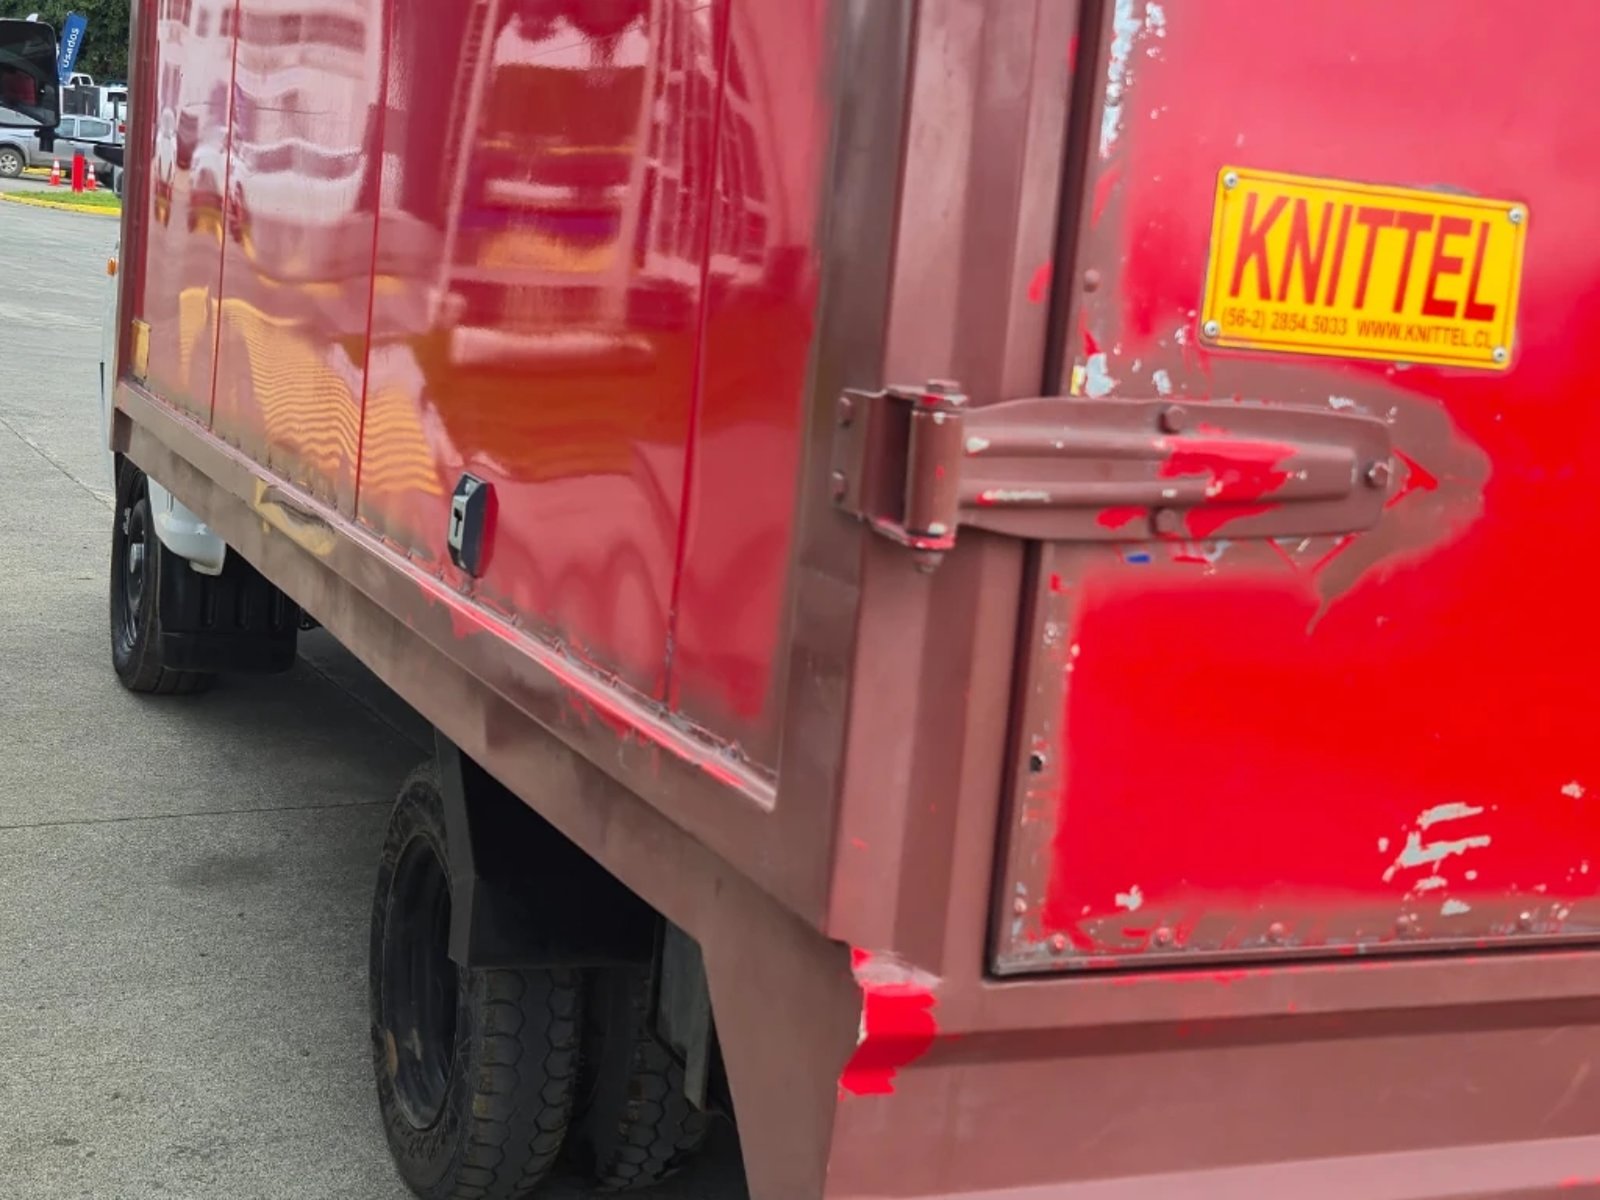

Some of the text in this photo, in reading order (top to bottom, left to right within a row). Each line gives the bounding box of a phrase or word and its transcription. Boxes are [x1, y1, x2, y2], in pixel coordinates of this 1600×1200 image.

[1229, 192, 1497, 322] KNITTEL
[1221, 306, 1492, 349] (56-2) 2854.5033 WWW.KNITTEL.CL
